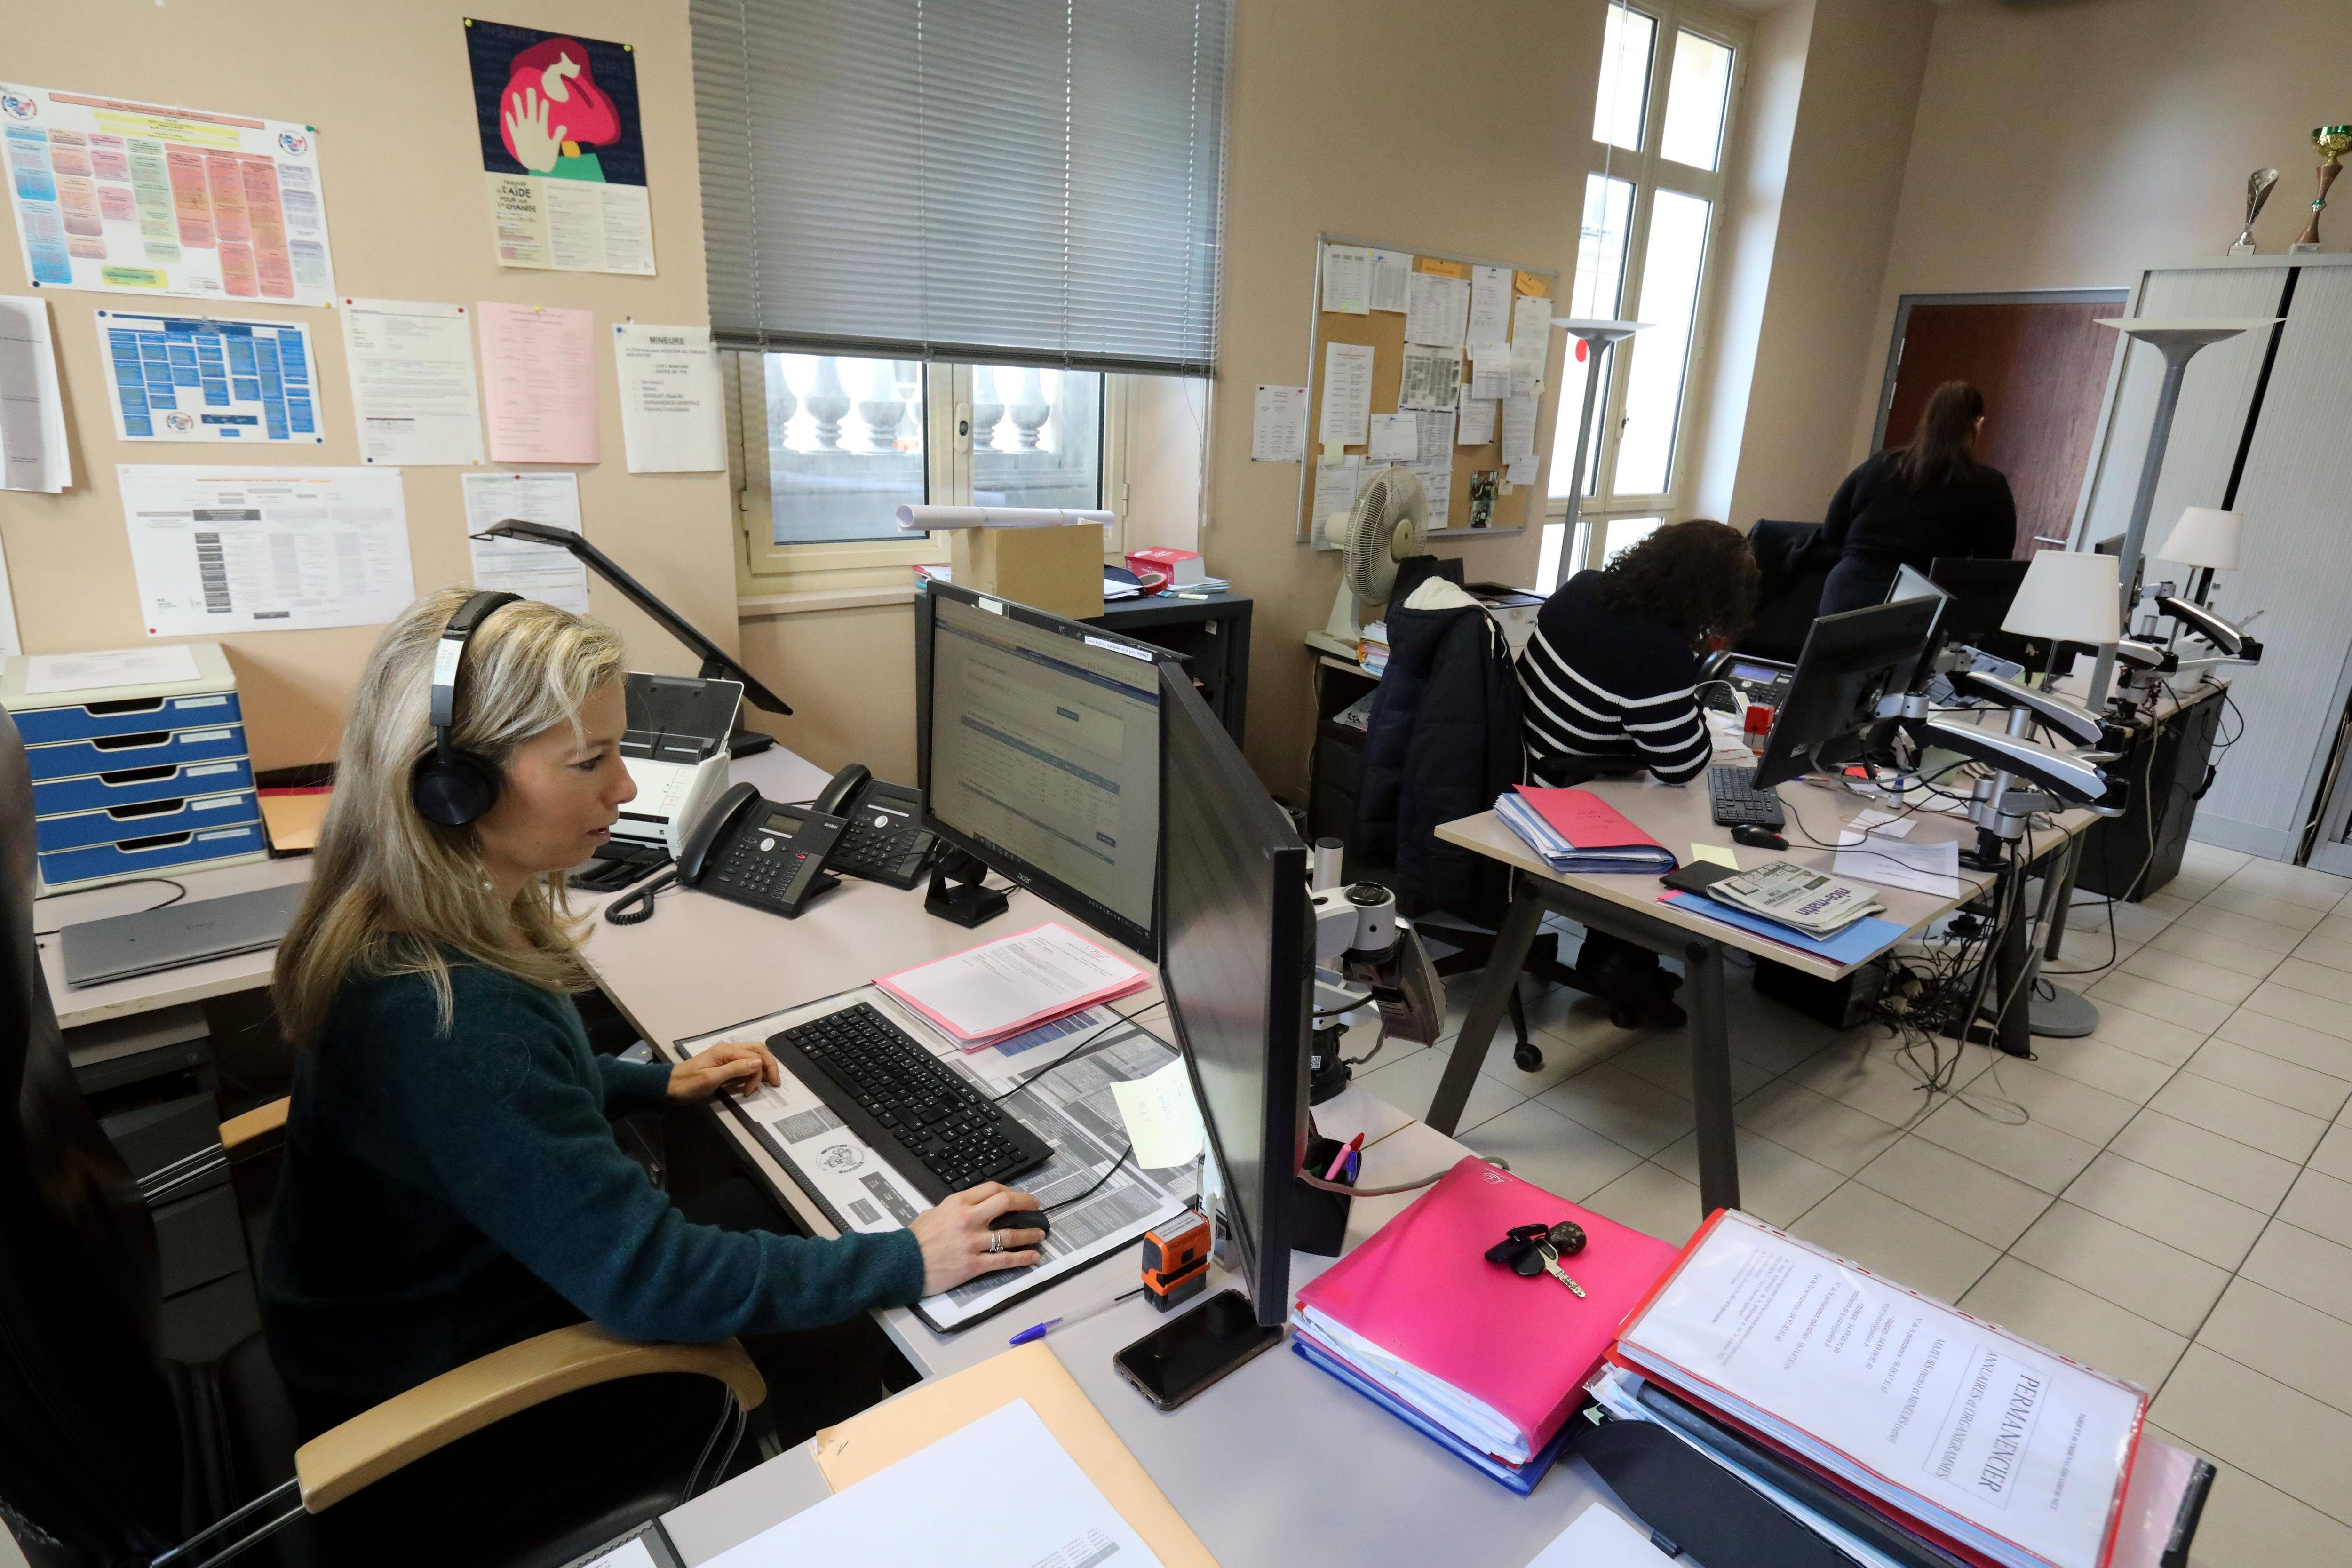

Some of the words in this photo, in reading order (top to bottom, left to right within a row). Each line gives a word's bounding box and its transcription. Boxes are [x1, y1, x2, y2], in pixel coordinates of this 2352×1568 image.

[1017, 873, 1031, 883] acer
[1796, 887, 1851, 916] nice-matin
[1790, 1288, 1813, 1312] permanence
[1811, 1294, 1833, 1319] permanence
[1849, 1304, 1866, 1321] mineurs
[1798, 1317, 1821, 1341] spécialisée
[1880, 1317, 1897, 1336] majeurs
[1893, 1331, 1915, 1359] permanence
[1922, 1337, 1946, 1370] MAJEURS
[1912, 1367, 1931, 1390] (recto)
[1968, 1349, 2000, 1401] ANNUAIRES
[1910, 1386, 1921, 1395] et
[1896, 1393, 1920, 1426] MINEURS
[1965, 1398, 1977, 1408] et
[1886, 1422, 1906, 1445] (verso)
[1934, 1406, 1977, 1480] ORGANIGRAMMES
[1977, 1373, 2041, 1496] PERMANENCIER
